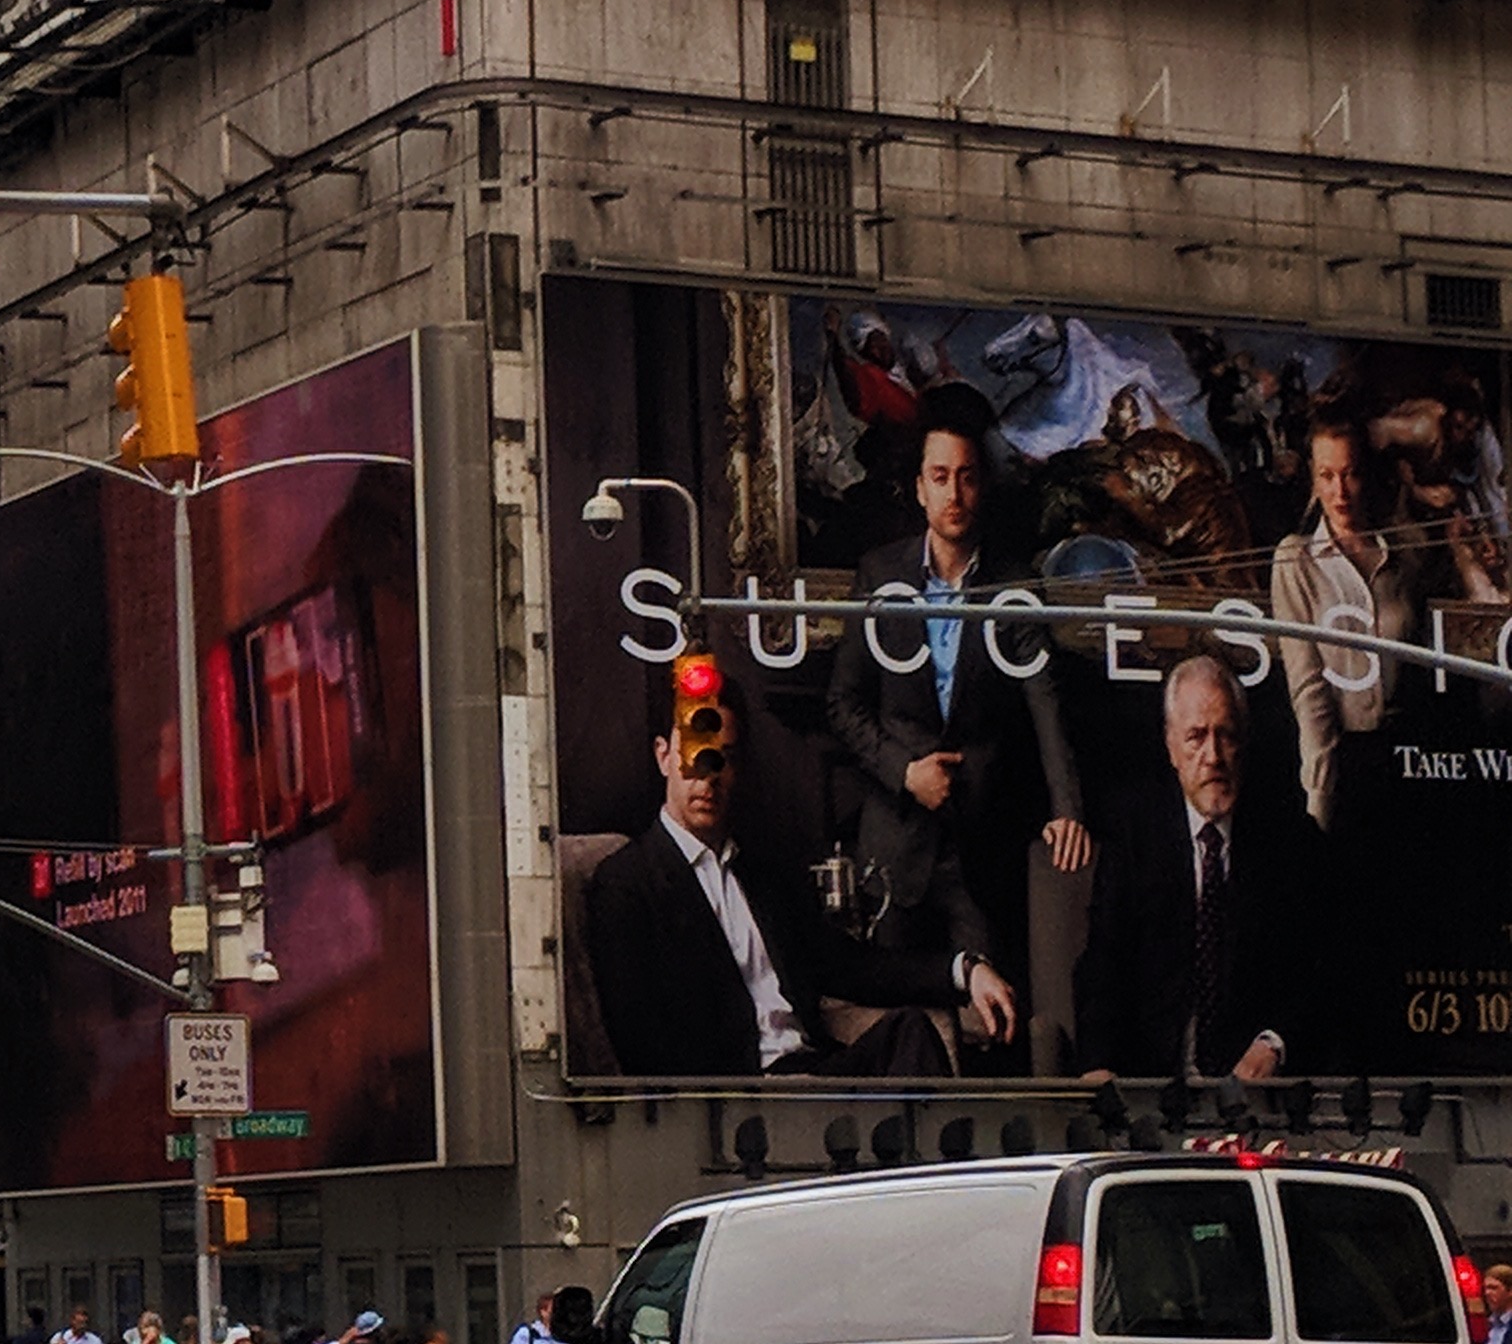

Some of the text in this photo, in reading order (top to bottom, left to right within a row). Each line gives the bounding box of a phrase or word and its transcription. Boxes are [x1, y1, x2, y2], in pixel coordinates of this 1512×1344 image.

[618, 567, 1512, 694] SUCCESSI
[1394, 745, 1467, 780] TAKE
[1476, 969, 1512, 986] PRE
[1406, 990, 1512, 1036] 6/3 10
[182, 1023, 233, 1041] BUSES
[188, 1044, 227, 1062] ONLY
[235, 1117, 304, 1139] Broadway
